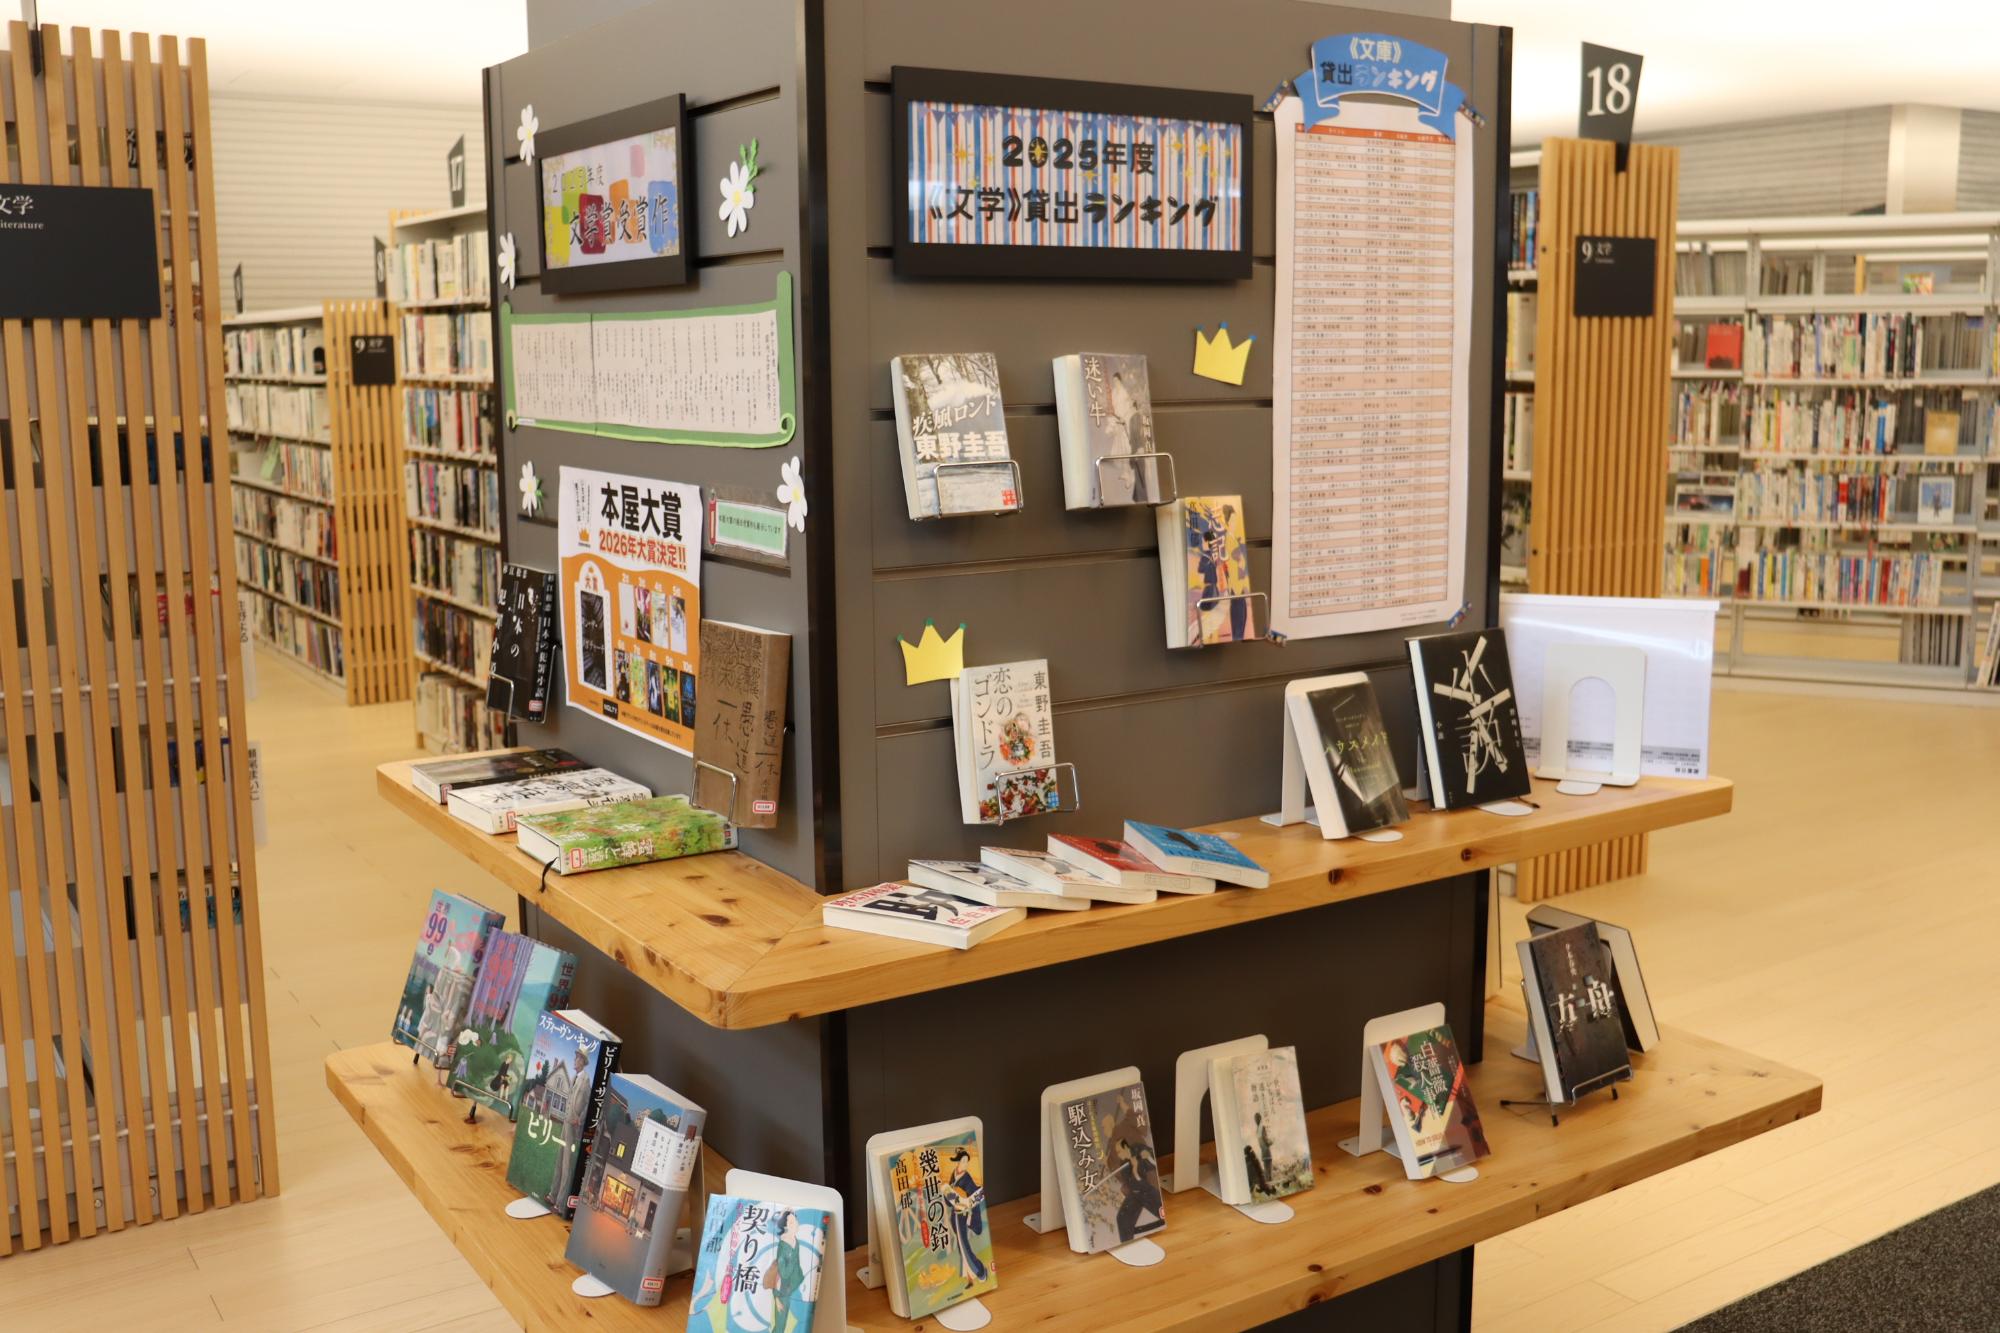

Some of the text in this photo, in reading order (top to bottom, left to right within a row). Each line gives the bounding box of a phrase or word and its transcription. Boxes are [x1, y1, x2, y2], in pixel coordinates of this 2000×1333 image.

[1350, 36, 1402, 63] 《文庫》
[1319, 60, 1438, 92] 貸出ランキング
[1586, 62, 1632, 117] 18
[1001, 134, 1155, 176] 2025年度
[0, 220, 44, 230] iterature
[569, 195, 667, 248] 文学賞受賞作
[929, 185, 1219, 227] 《文学》貸出ランキング
[1582, 241, 1593, 264] 9
[355, 338, 366, 354] 9
[912, 394, 996, 437] 疾風ロンド
[1084, 357, 1107, 428] 迷い牛
[913, 430, 1008, 460] 東野圭吾
[601, 481, 682, 541] 本屋大賞
[992, 666, 1014, 717] 恋の
[1033, 671, 1052, 759] 東野圭吾
[712, 698, 738, 744] 一休
[974, 673, 996, 770] ゴンドラ
[425, 912, 448, 944] 99
[538, 1013, 600, 1053] スティーヴン・キング
[1411, 1052, 1439, 1121] 殺人事件
[1420, 1041, 1448, 1093] 白薔薇
[1066, 1102, 1099, 1194] 駆込み女
[918, 1148, 950, 1252] 幾世の鈴
[732, 1204, 770, 1295] 契り橋
